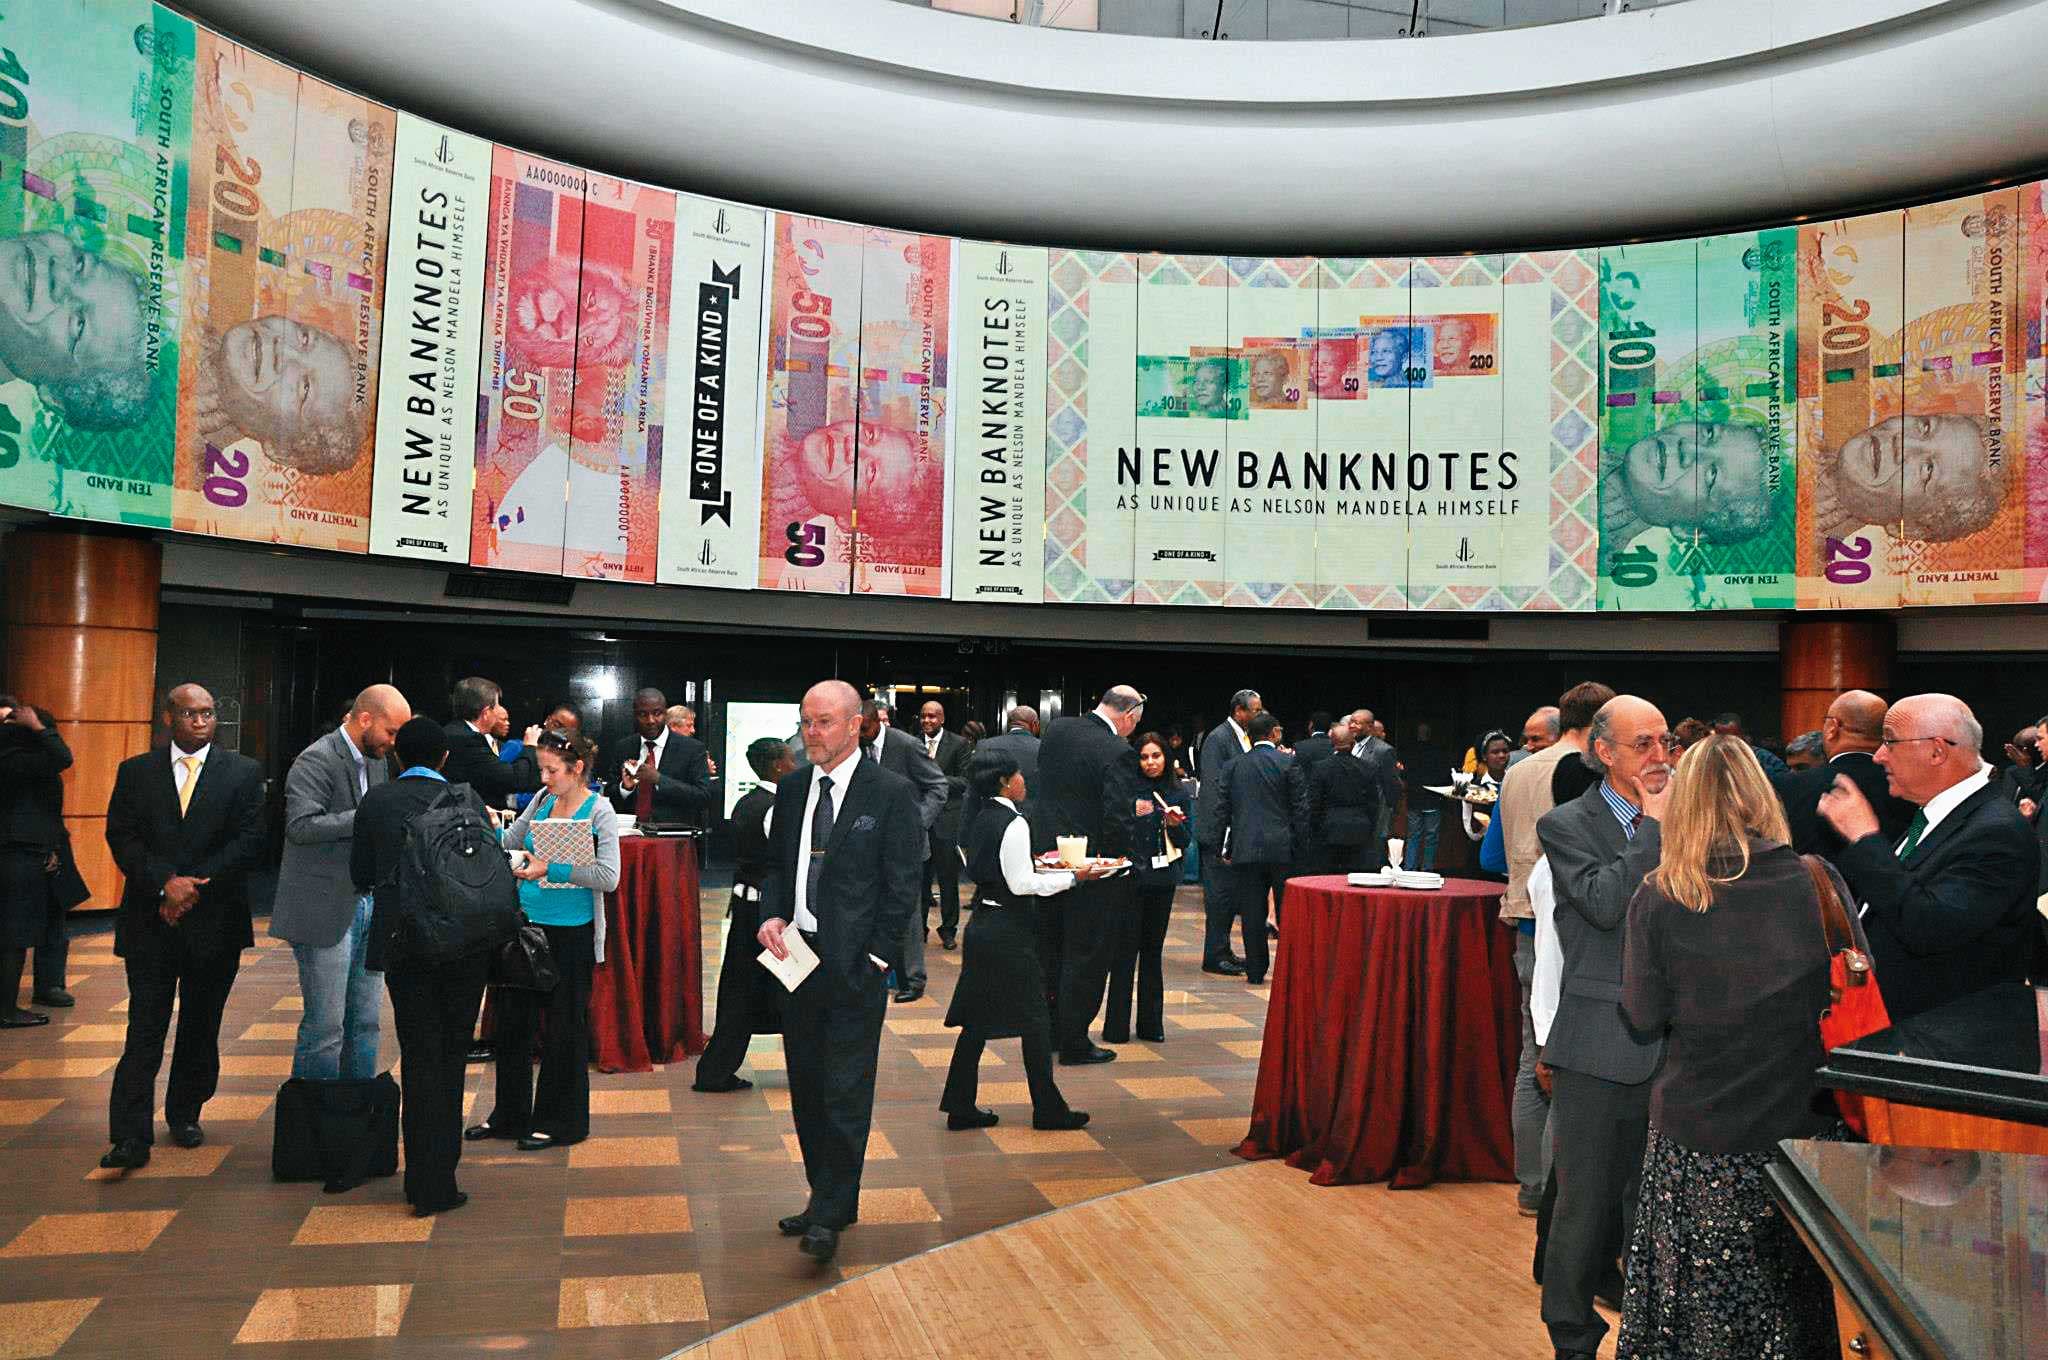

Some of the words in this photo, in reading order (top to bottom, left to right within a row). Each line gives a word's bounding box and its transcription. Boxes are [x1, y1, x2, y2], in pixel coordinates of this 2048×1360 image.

[157, 87, 173, 149] SOUTH
[151, 153, 169, 236] AFRICAN
[214, 145, 262, 217] 20
[366, 167, 378, 217] SOUTH
[452, 195, 466, 261] HIMSELF
[148, 239, 164, 317] RESERVE
[361, 223, 375, 289] AFRICA
[1989, 248, 2002, 294] SOUTH
[407, 188, 448, 416] BANKNOTES
[446, 268, 462, 339] MANDELA
[790, 291, 832, 338] 50
[923, 279, 934, 317] SOUTH
[1768, 281, 1780, 327] SOUTH
[145, 321, 161, 373] BANK
[358, 294, 371, 357] RESERVE
[700, 310, 722, 366] KIND
[1015, 299, 1026, 352] HIMSELF
[1609, 321, 1656, 365] 10
[1822, 298, 1871, 351] 20
[1988, 300, 2002, 362] AFRICA
[921, 322, 932, 374] AFRICAN
[1470, 354, 1493, 369] 200
[1768, 331, 1780, 394] AFRICAN
[355, 362, 367, 405] BANK
[443, 348, 456, 398] NELSON
[503, 368, 545, 420] 50
[700, 375, 720, 389] A
[981, 298, 1009, 484] BANKNOTES
[1014, 359, 1025, 418] MANDELA
[1286, 388, 1300, 402] 20
[1344, 378, 1359, 392] 50
[1404, 367, 1427, 381] 100
[1988, 366, 2001, 425] RESERVE
[441, 407, 453, 425] AS
[697, 393, 719, 421] OF
[919, 377, 931, 427] RESERVE
[1768, 396, 1780, 451] RESERVE
[439, 434, 452, 490] UNIQUE
[696, 428, 718, 475] ONE
[918, 431, 929, 463] BANK
[1013, 425, 1024, 467] NELSON
[1118, 447, 1219, 487] NEW
[1238, 451, 1518, 491] BANKNOTES
[1989, 429, 2001, 467] BANK
[87, 475, 123, 491] RAND
[127, 478, 152, 496] TEN
[202, 442, 249, 507] 20
[402, 428, 433, 516] NEW
[1013, 475, 1023, 489] AS
[1767, 455, 1780, 494] BANK
[291, 509, 319, 523] RAND
[320, 512, 358, 528] TWENTY
[437, 500, 449, 518] AS
[1012, 497, 1023, 544] UNIQUE
[1117, 495, 1139, 510] AS
[1151, 496, 1219, 511] UNIQUE
[1230, 498, 1251, 513] AS
[1263, 499, 1325, 515] NELSON
[1337, 500, 1427, 515] MANDELA
[1438, 500, 1520, 515] HIMSELF
[785, 522, 826, 567] 50
[979, 496, 1006, 566] NEW
[874, 565, 899, 573] RAND
[902, 566, 926, 575] FIFTY
[1011, 552, 1022, 567] AS
[1611, 545, 1658, 588] 10
[1724, 575, 1754, 584] RAND
[1757, 575, 1779, 584] TEN
[1824, 537, 1872, 585] 20
[1917, 574, 1949, 583] RAND
[1951, 572, 1999, 582] TWENTY
